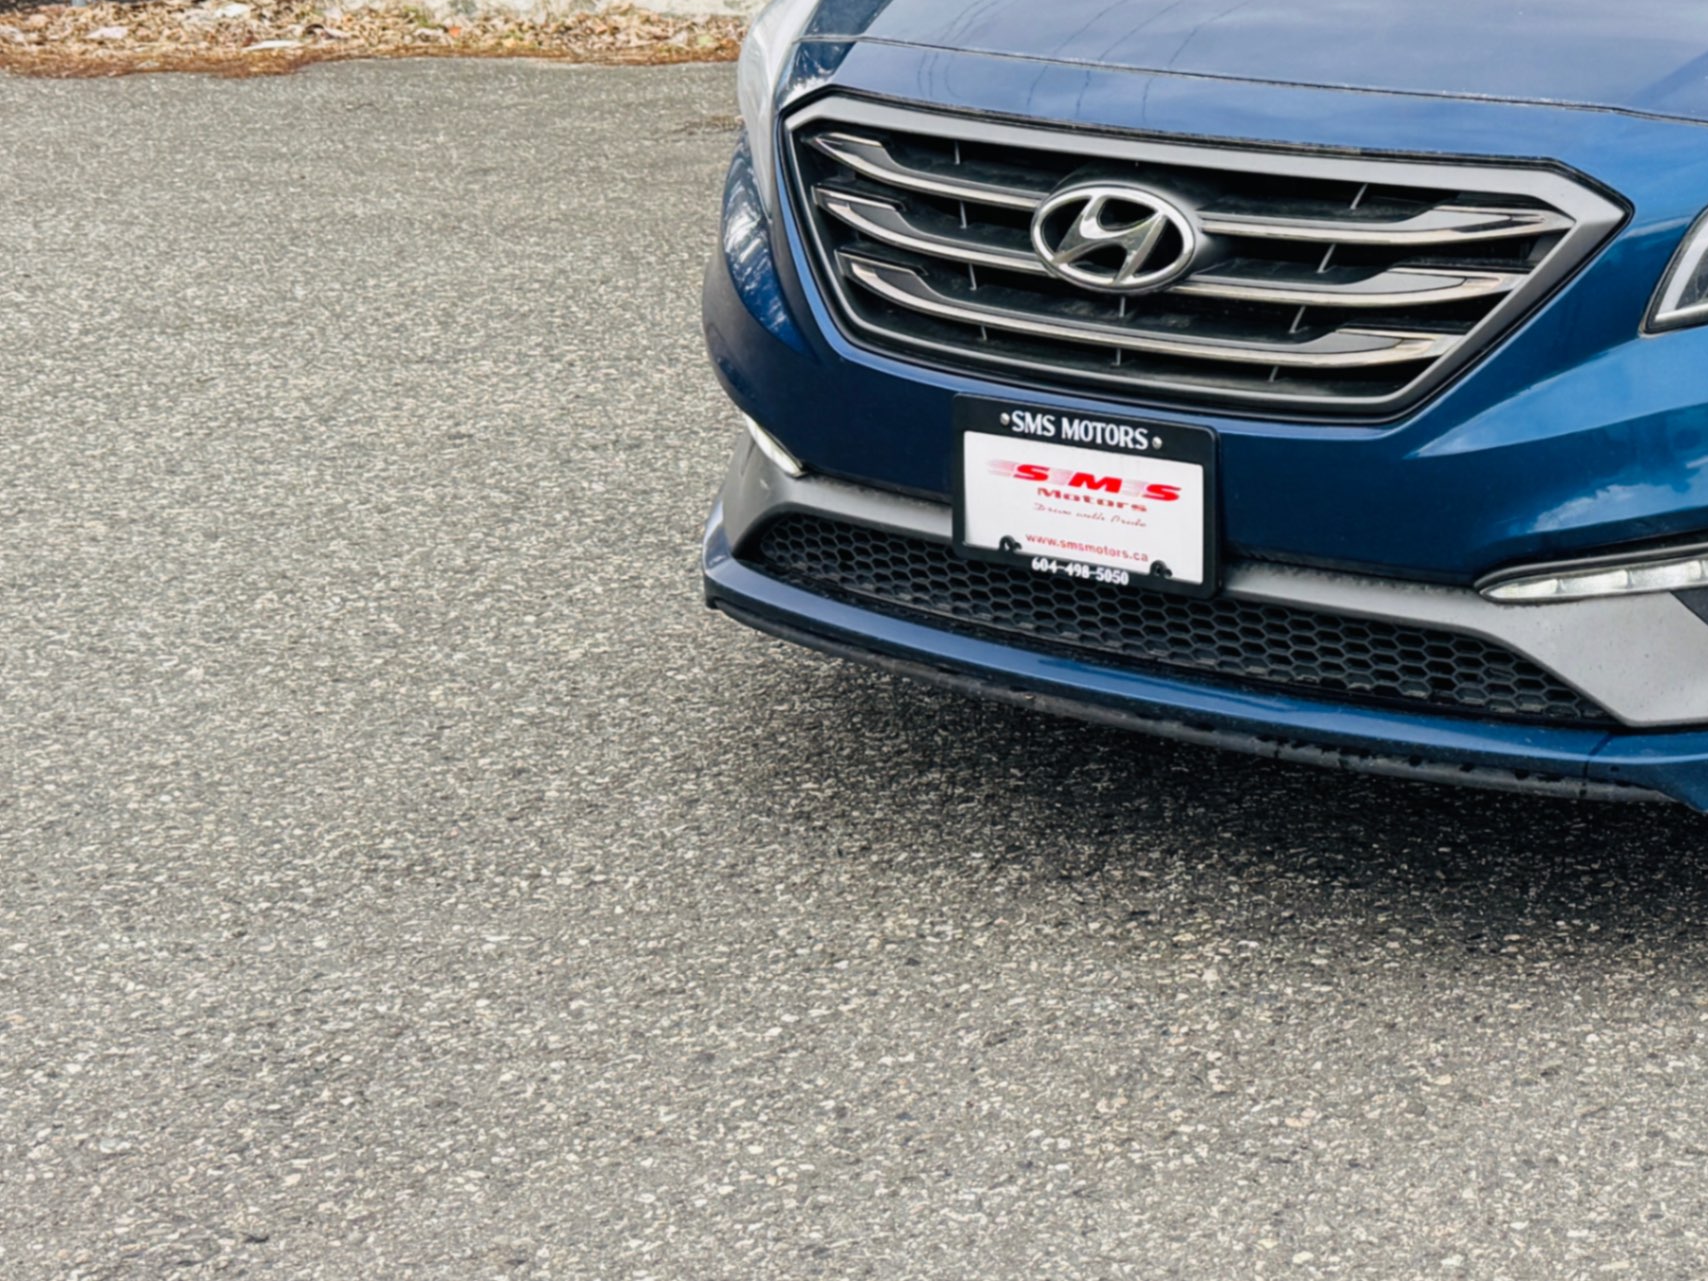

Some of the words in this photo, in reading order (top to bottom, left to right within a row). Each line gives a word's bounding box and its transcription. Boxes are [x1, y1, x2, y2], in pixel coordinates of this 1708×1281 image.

[1011, 410, 1055, 437] SMS
[1061, 417, 1149, 450] MOTORS
[1013, 464, 1182, 502] SMS
[1037, 487, 1147, 512] Motors
[1025, 533, 1149, 562] www.smsmotors.ca
[1031, 557, 1129, 585] 604-498-5050
